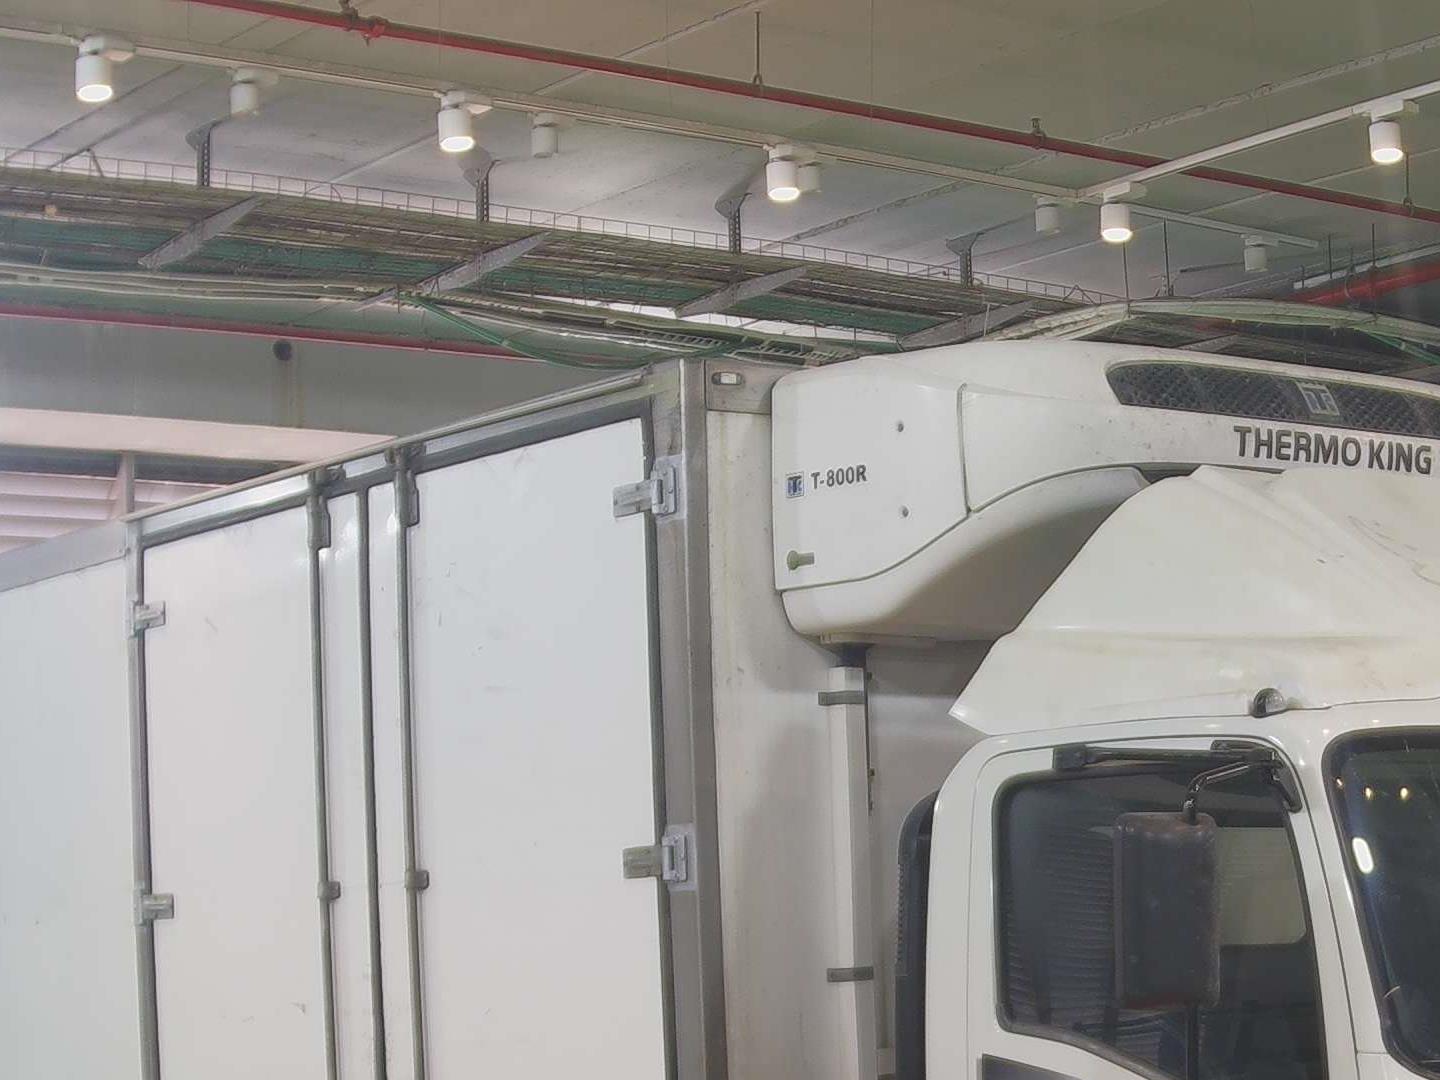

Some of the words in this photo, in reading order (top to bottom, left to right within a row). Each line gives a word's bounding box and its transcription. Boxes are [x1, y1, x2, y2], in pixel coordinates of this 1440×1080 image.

[1233, 426, 1361, 467] THERMO
[1367, 438, 1432, 475] KING
[810, 464, 868, 490] T-800R
